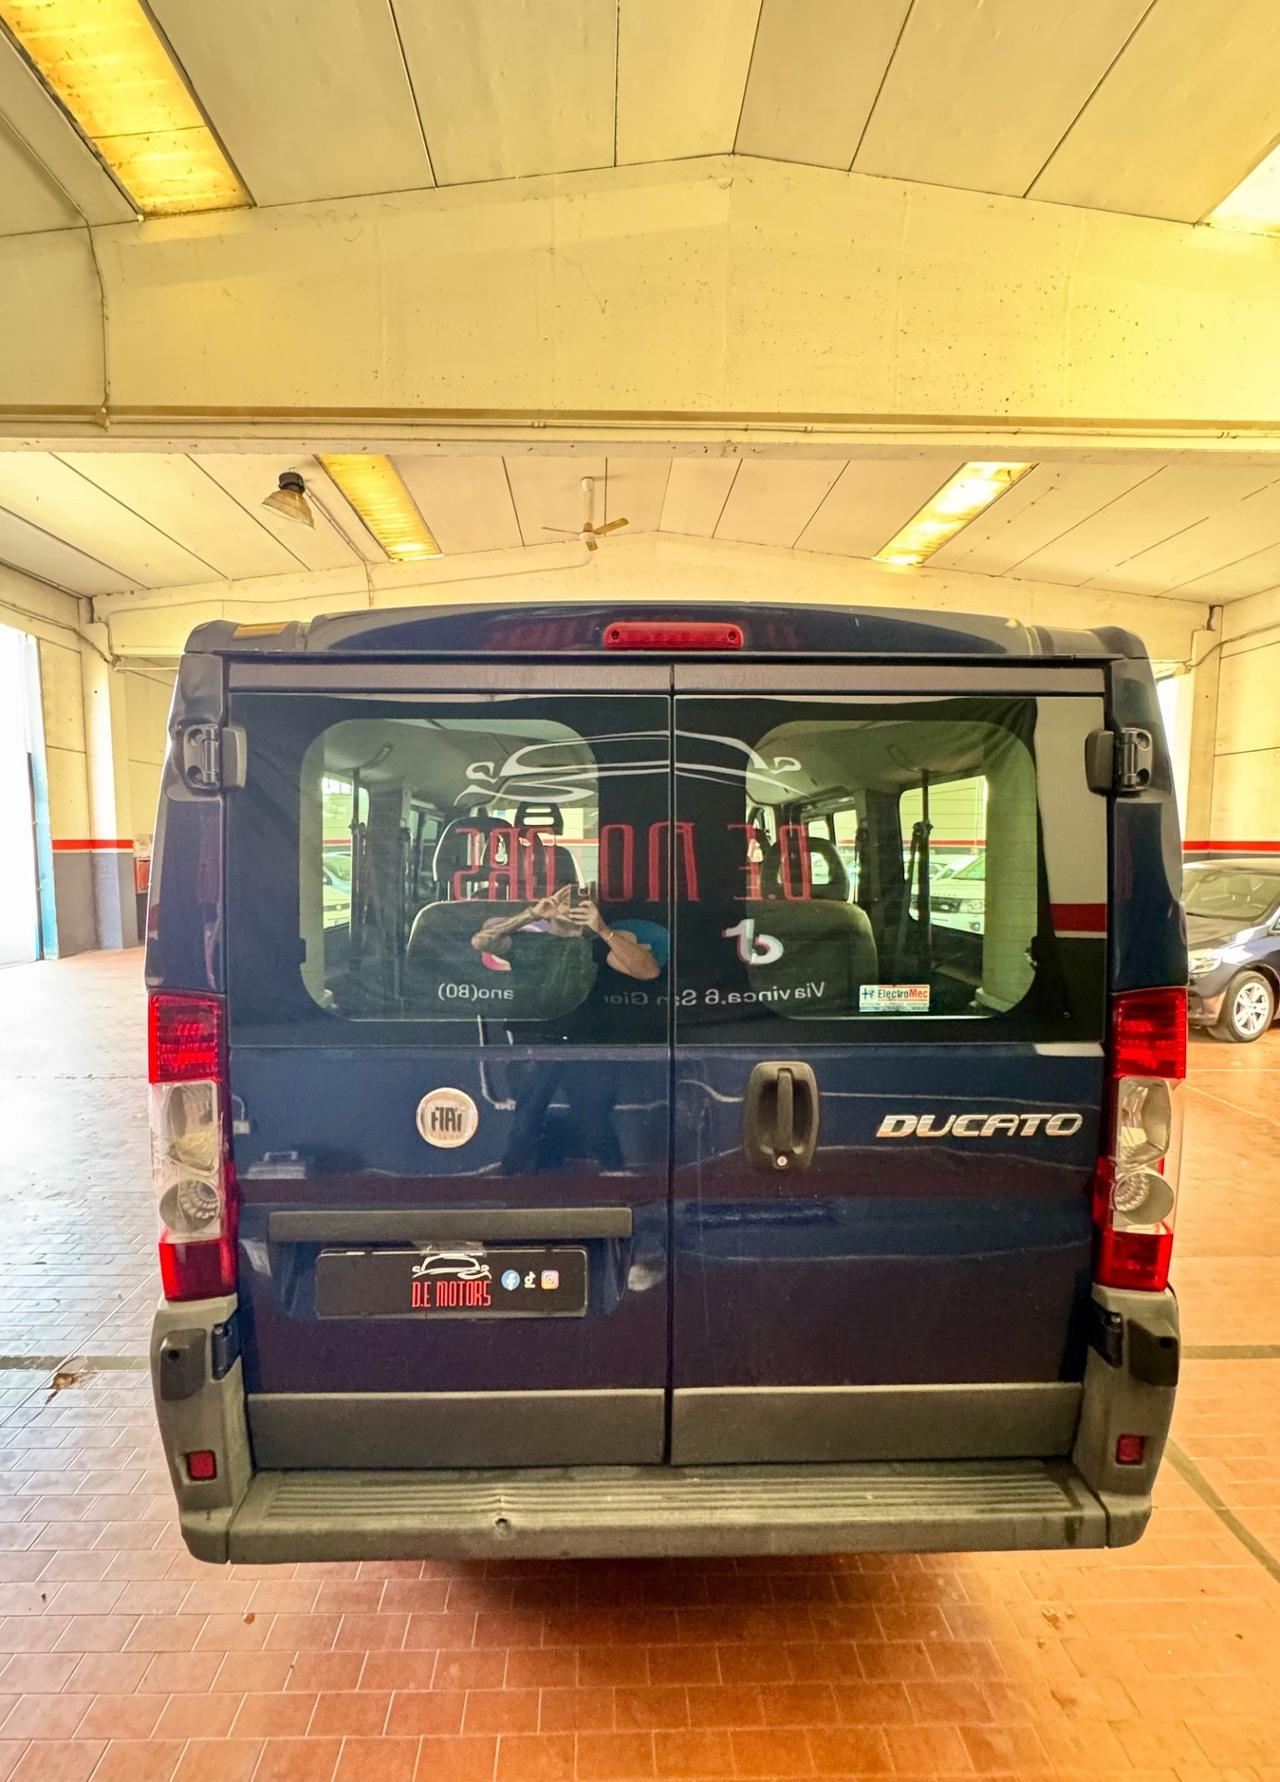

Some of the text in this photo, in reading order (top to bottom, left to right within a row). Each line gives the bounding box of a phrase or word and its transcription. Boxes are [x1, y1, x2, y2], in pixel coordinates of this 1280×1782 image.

[877, 988, 928, 1000] ElectroMec
[431, 1106, 463, 1132] FIAT
[876, 1113, 1083, 1138] DUCATO
[411, 1280, 492, 1308] D.E MOTORS
